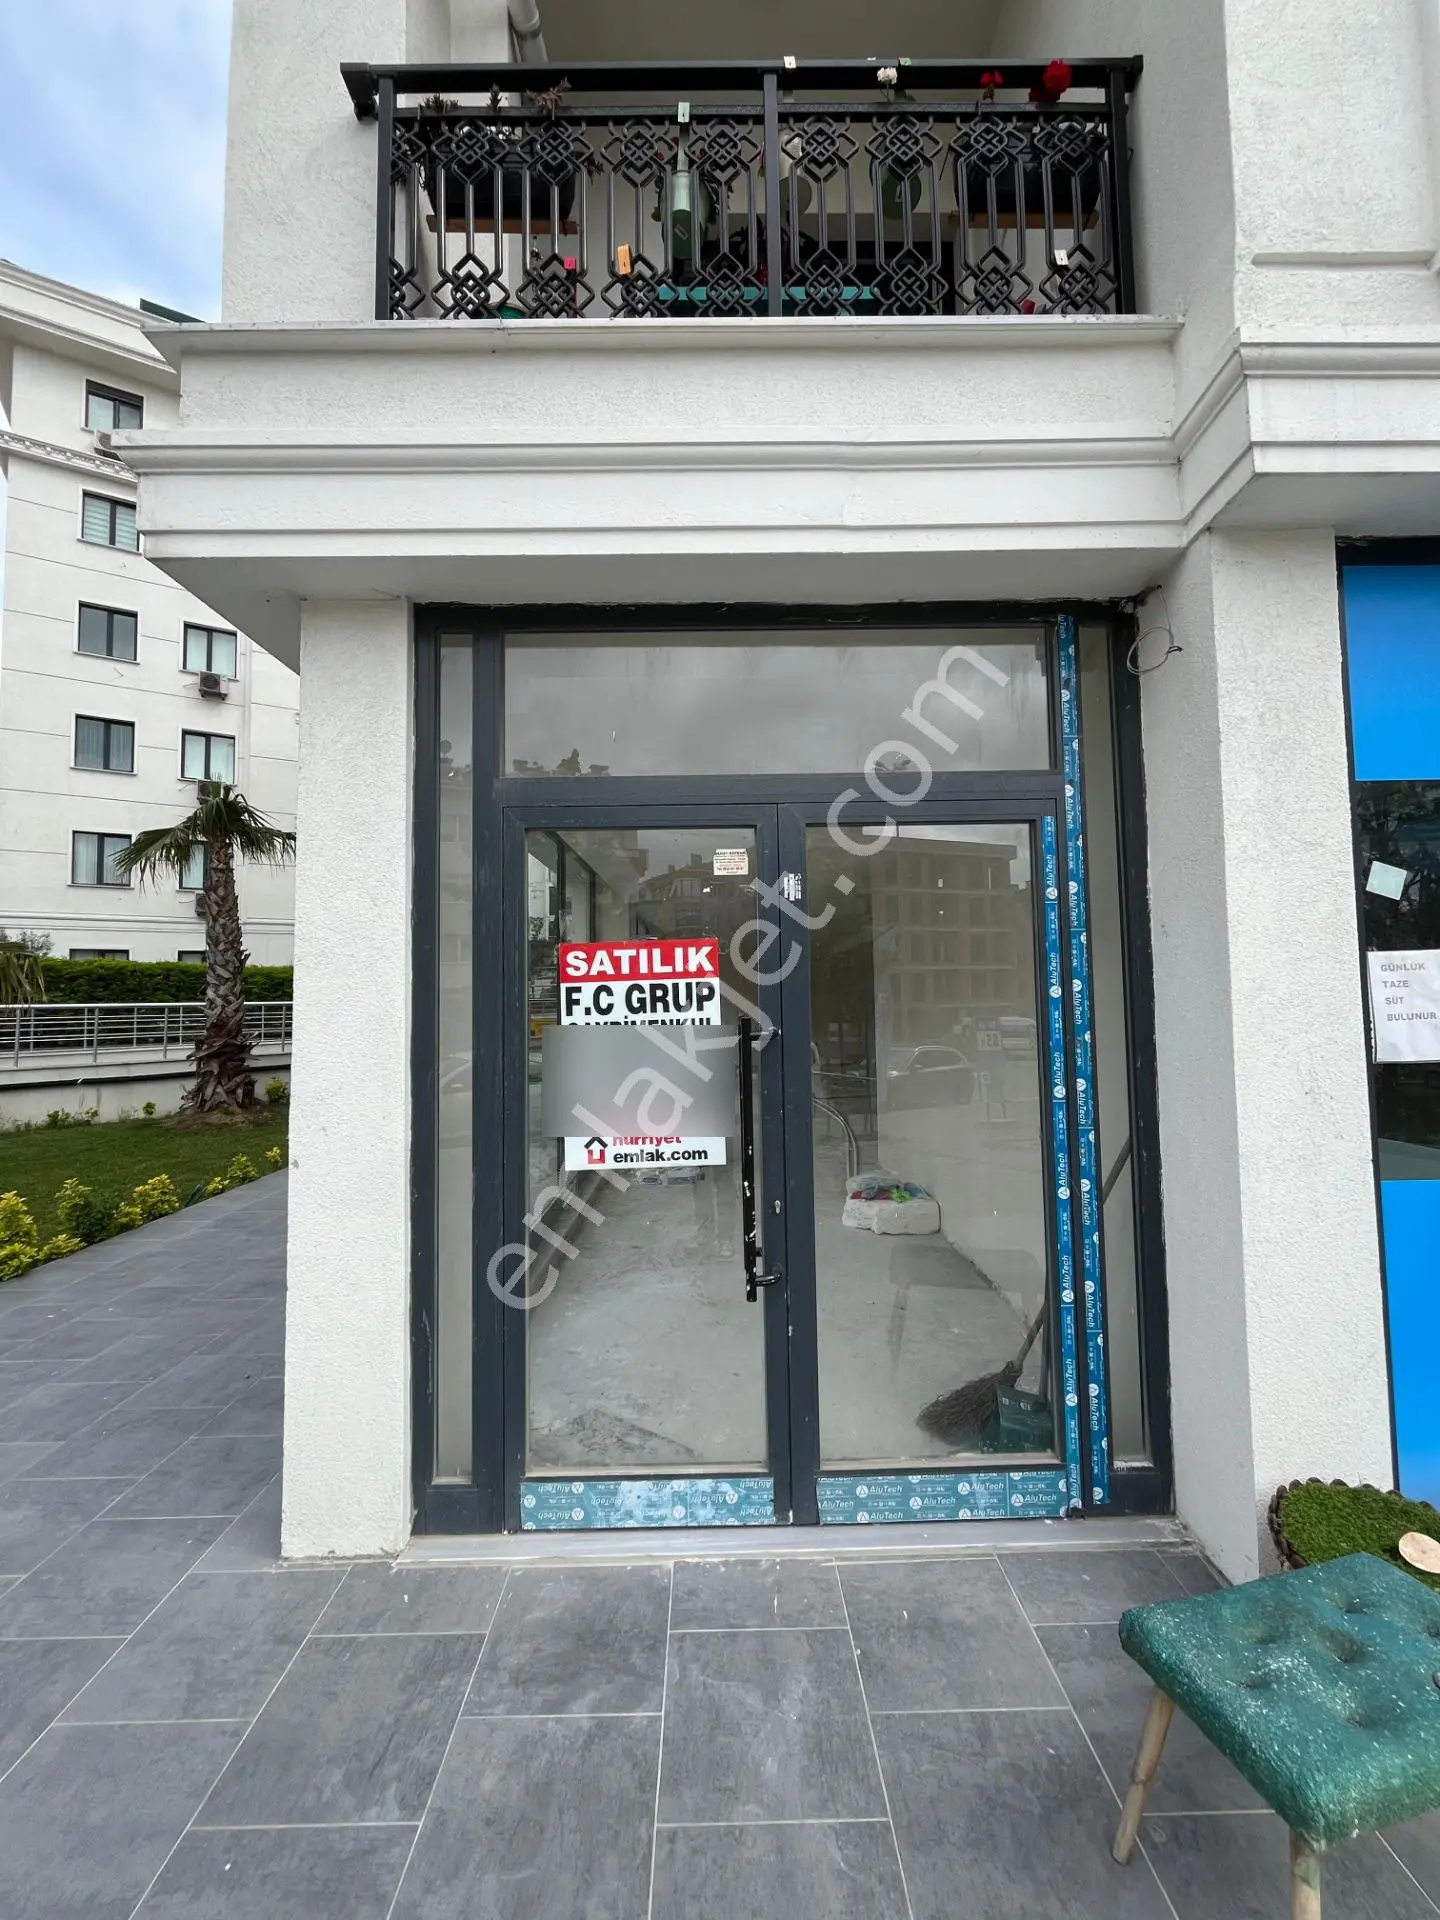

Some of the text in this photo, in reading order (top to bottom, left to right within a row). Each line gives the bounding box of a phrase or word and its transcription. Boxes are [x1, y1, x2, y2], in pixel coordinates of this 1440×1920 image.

[1045, 854, 1053, 887] AluTech
[566, 946, 714, 977] SATILIK
[565, 982, 715, 1017] F.C GRUP
[1381, 980, 1409, 988] TAZE
[1387, 1012, 1437, 1021] BULUNUR
[1053, 1052, 1062, 1085] AluTech
[1078, 1092, 1086, 1125] AluTech
[613, 1149, 708, 1163] emlak.com
[1057, 1152, 1066, 1186] AluTech
[1061, 1255, 1069, 1289] AluTech
[1087, 1294, 1095, 1328] AluTech
[1065, 1358, 1074, 1393] AluTech
[1090, 1396, 1099, 1431] AluTech
[869, 1485, 903, 1493] AluTech
[971, 1482, 1004, 1490] AluTech
[1070, 1463, 1078, 1497] AluTech
[821, 1500, 854, 1508] AluTech
[923, 1497, 956, 1505] AluTech
[1024, 1494, 1057, 1502] AluTech
[870, 1511, 904, 1519] AluTech
